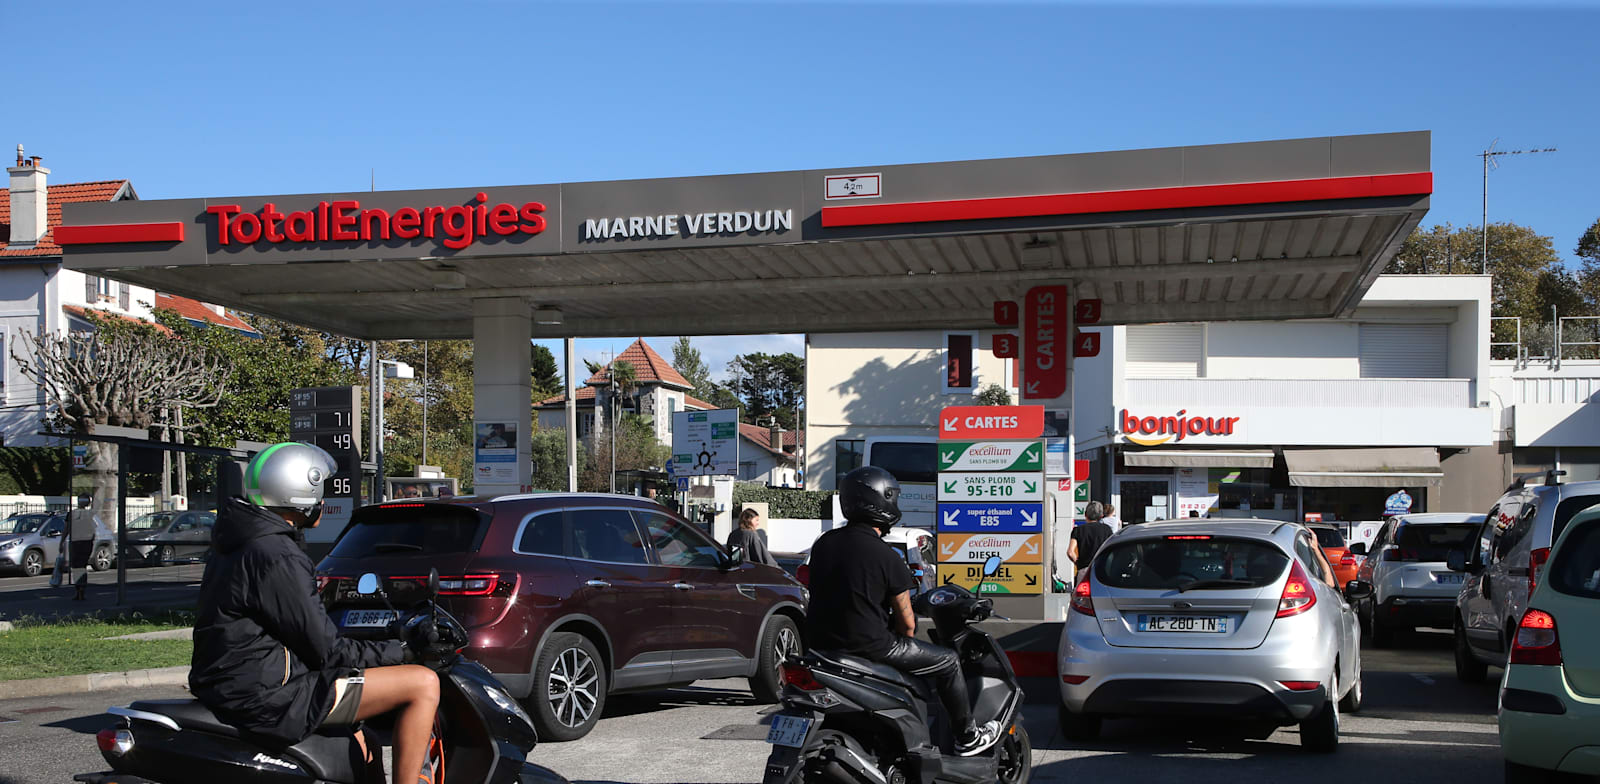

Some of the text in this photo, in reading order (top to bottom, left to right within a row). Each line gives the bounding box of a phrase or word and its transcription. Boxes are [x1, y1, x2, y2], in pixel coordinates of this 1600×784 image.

[206, 192, 546, 249] TotalEnergies
[585, 209, 793, 239] MARNE VERDUN
[1000, 305, 1008, 320] 1
[1083, 304, 1093, 318] 2
[1036, 292, 1055, 370] CARTES
[1000, 339, 1009, 353] 3
[1082, 337, 1093, 352] 4
[334, 412, 351, 427] 71
[964, 416, 1018, 429] CARTES
[1122, 408, 1240, 441] bonjour
[333, 434, 351, 450] 49
[969, 446, 1012, 456] excellium
[333, 478, 351, 494] 96
[967, 485, 1013, 496] 95-E10
[967, 509, 986, 517] super
[980, 516, 1000, 526] E85
[968, 538, 1011, 547] excellium
